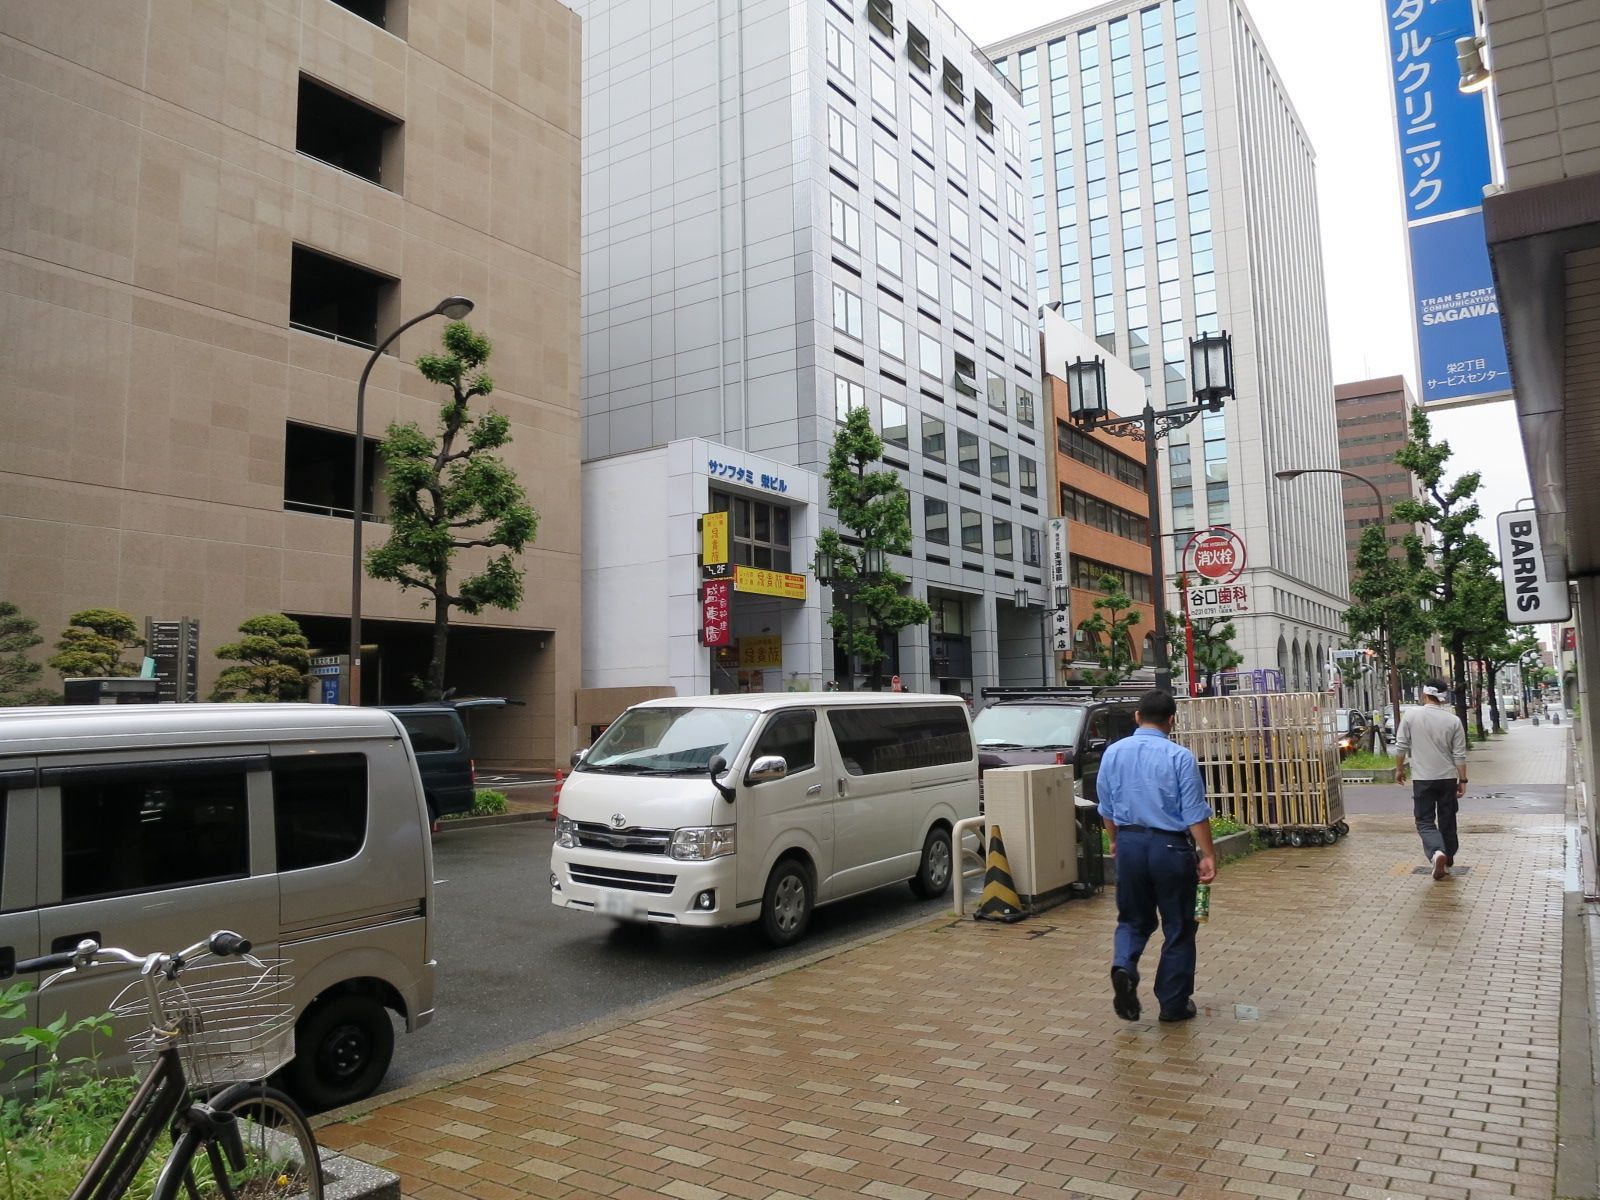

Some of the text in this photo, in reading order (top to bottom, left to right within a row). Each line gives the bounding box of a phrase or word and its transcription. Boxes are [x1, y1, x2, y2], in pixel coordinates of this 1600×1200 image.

[1423, 294, 1497, 313] COMMUNICATION
[1422, 302, 1499, 326] SAGAWA
[1446, 358, 1485, 374] 栄2丁目
[1427, 369, 1509, 390] サービスセンター
[708, 459, 788, 493] サンフタミ 栄ビル
[1197, 548, 1233, 567] 消火栓
[1509, 520, 1540, 612] BARNS
[716, 565, 726, 574] 2F
[1190, 585, 1248, 606] 谷口歯科
[326, 690, 335, 703] P
